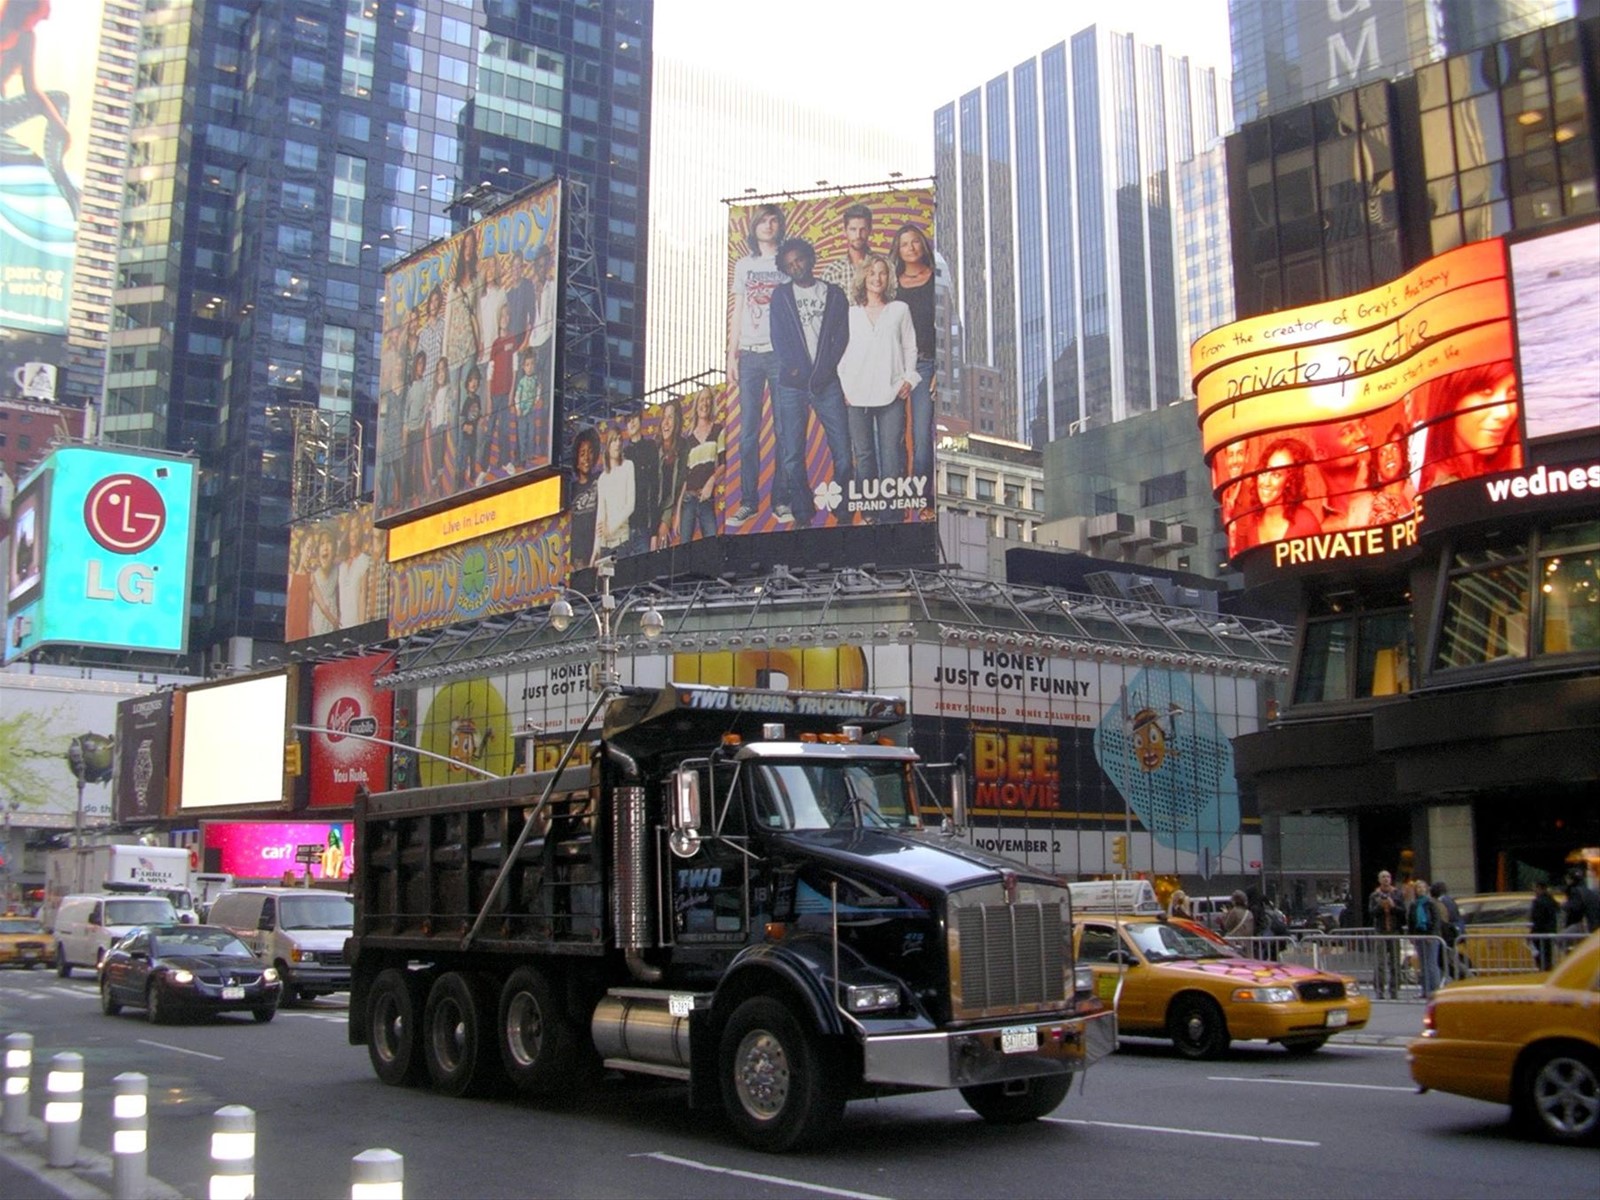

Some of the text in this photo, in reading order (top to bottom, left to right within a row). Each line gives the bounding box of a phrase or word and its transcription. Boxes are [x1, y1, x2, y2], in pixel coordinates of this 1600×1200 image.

[482, 195, 554, 262] BODY
[1233, 333, 1253, 346] the
[1264, 318, 1324, 338] creator
[1333, 308, 1348, 325] of
[1227, 319, 1433, 419] private practice
[848, 475, 928, 500] LUCKY
[1486, 465, 1600, 502] wednes
[848, 497, 928, 512] BRAND JEANS
[1275, 528, 1384, 567] PRIVATE
[86, 560, 154, 604] LG
[551, 661, 591, 680] HONEY
[983, 651, 1046, 672] HONEY
[522, 685, 548, 700] JUST
[551, 680, 576, 696] GOT
[934, 667, 1091, 697] JUST GOT FUNNY
[691, 690, 729, 710] TWO
[935, 702, 962, 712] JERRY
[975, 733, 1059, 783] BEE
[333, 768, 349, 784] You
[975, 783, 1061, 810] MOVIE
[261, 843, 292, 860] car?
[976, 839, 1061, 853] NOVEMBER 2
[678, 867, 722, 888] TWO
